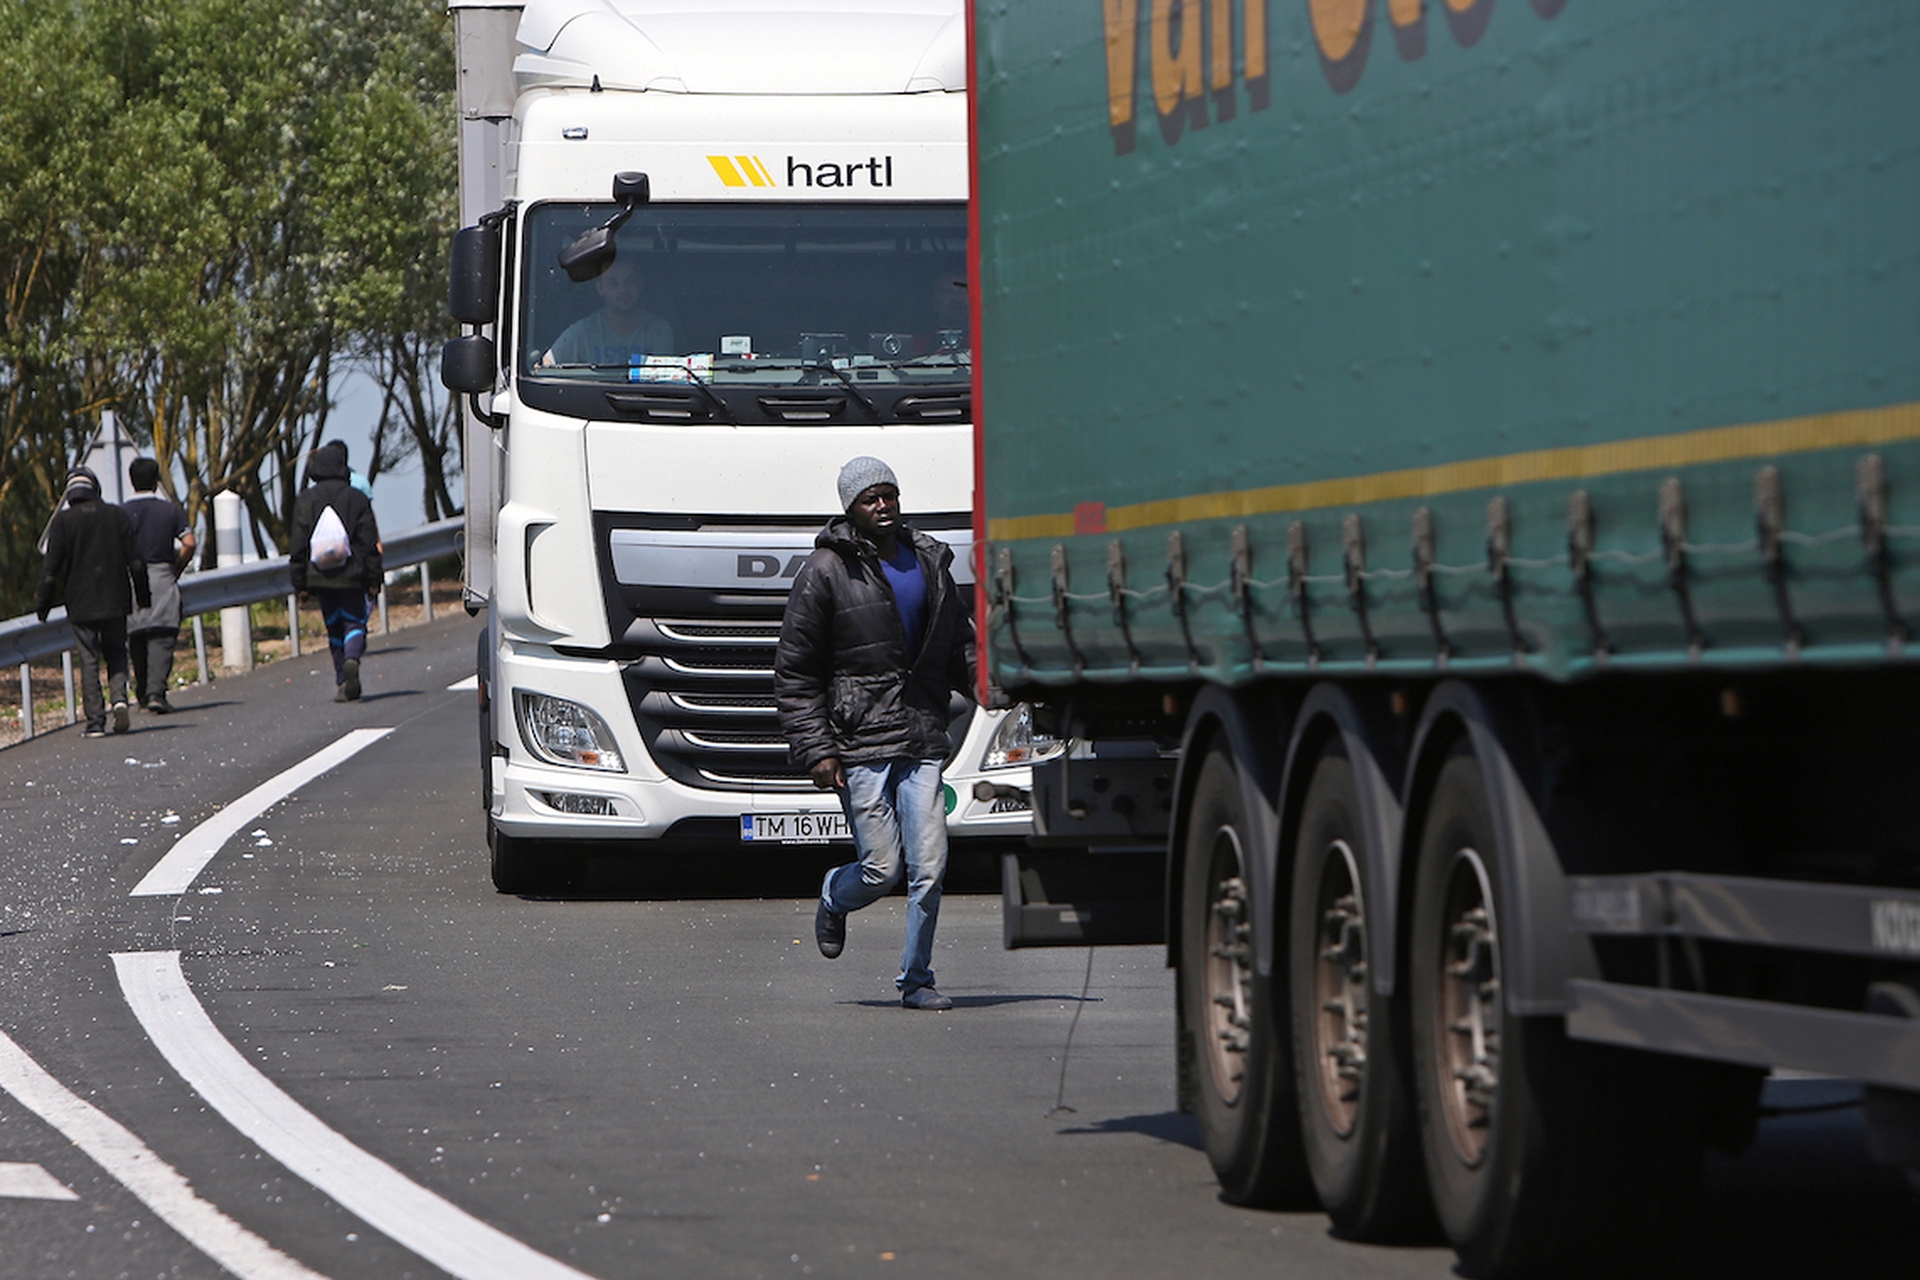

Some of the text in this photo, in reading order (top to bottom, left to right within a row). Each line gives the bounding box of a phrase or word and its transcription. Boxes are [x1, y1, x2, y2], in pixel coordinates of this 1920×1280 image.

[787, 155, 892, 188] hartl
[737, 554, 811, 578] DA
[756, 816, 852, 837] TM 16 WH
